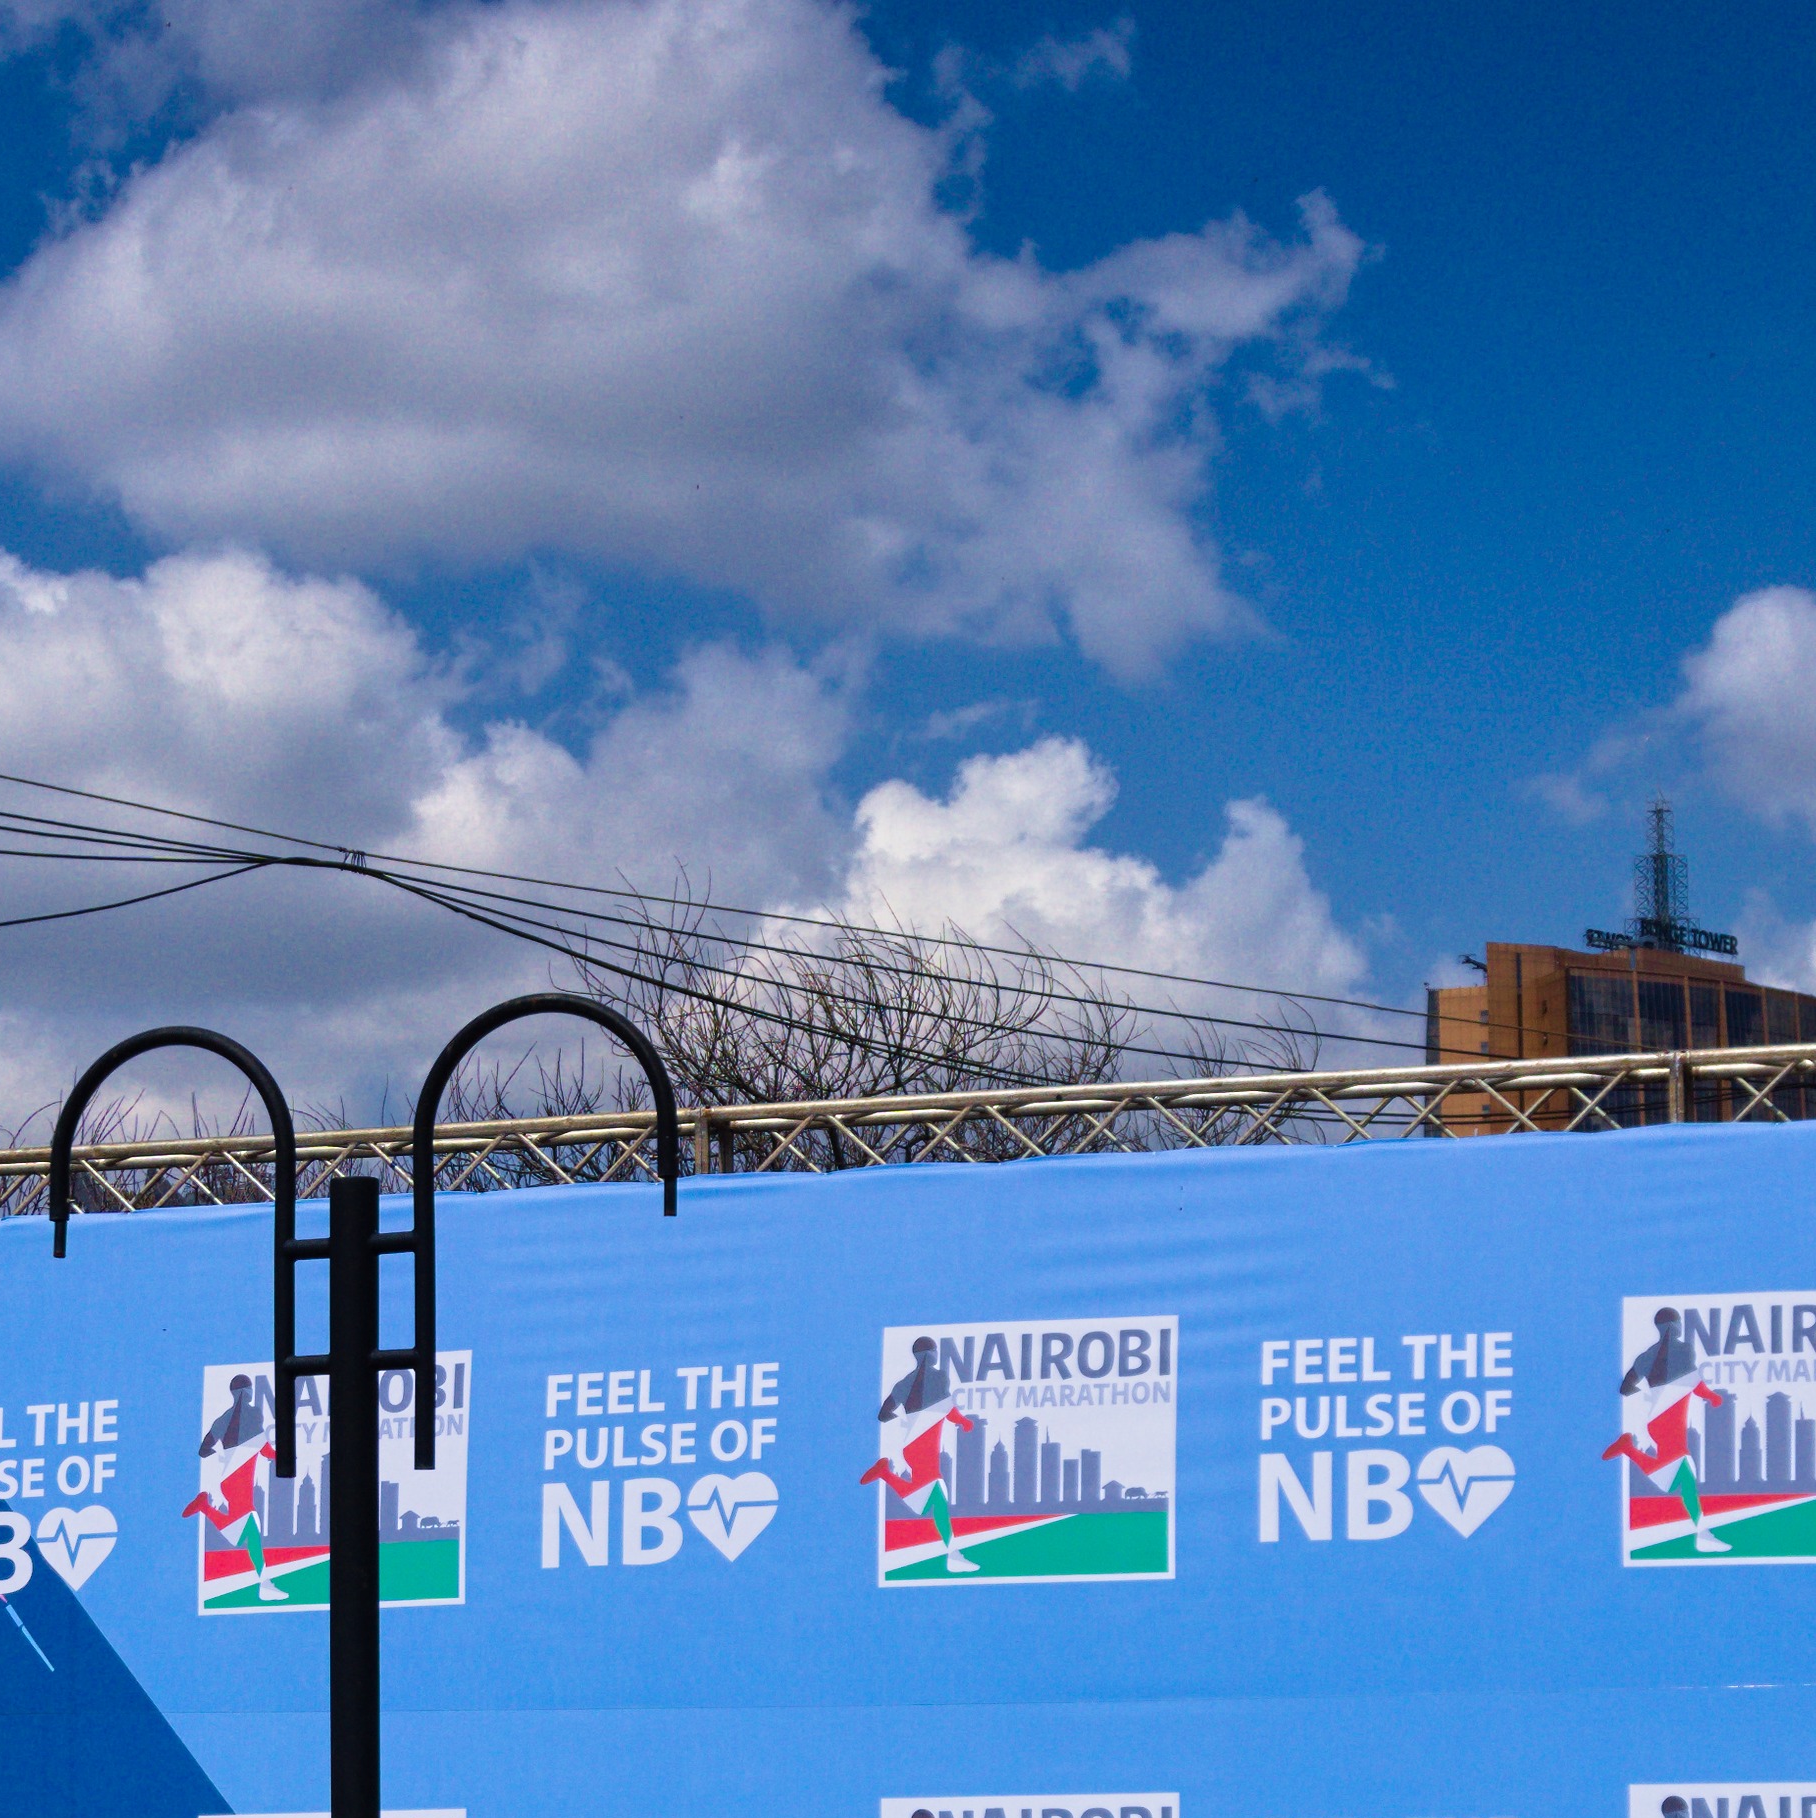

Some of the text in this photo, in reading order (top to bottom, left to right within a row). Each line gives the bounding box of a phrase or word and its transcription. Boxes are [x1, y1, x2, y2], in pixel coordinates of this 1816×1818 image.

[938, 1328, 1171, 1383] NAIROBI
[1261, 1332, 1513, 1386] FEEL THE
[1699, 1361, 1759, 1385] CITY
[546, 1362, 779, 1417] FEEL THE
[953, 1380, 1171, 1410] CITY MARATHON
[26, 1400, 118, 1446] THE
[1261, 1390, 1512, 1440] PULSE OF
[544, 1418, 777, 1470] PULSE OF
[57, 1454, 116, 1495] OF
